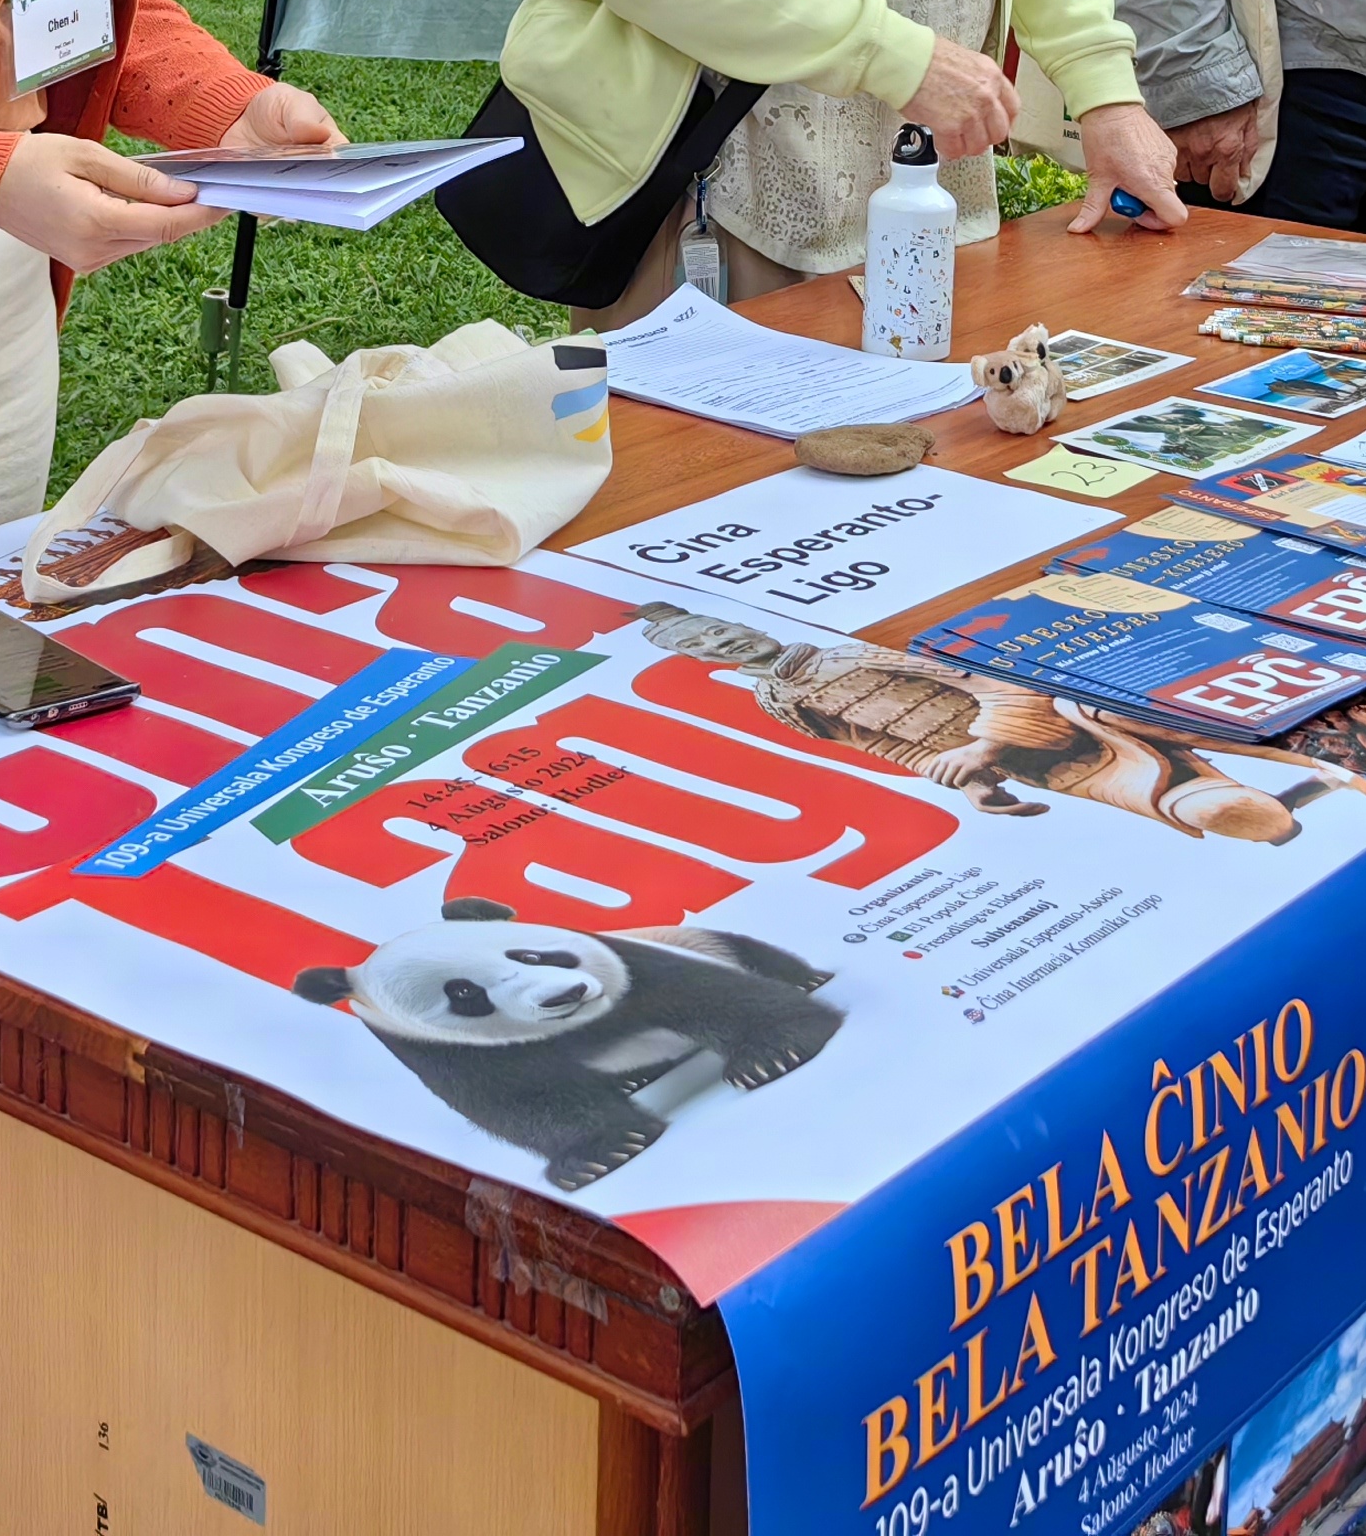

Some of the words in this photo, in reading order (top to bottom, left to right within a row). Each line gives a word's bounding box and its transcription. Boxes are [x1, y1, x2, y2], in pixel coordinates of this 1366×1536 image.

[48, 16, 69, 33] Chen
[71, 9, 79, 24] Ji
[1051, 461, 1118, 487] 23
[629, 518, 761, 565] Ĉina
[697, 493, 944, 585] Esperanto-
[766, 560, 891, 605] Ligo
[996, 610, 1110, 653] UNESKO
[1056, 611, 1161, 654] KURIERO
[1173, 657, 1341, 717] EPC
[94, 831, 172, 871] 109-a
[164, 768, 272, 833] Universala
[261, 718, 353, 776] Kongreso
[345, 702, 378, 722] de
[362, 656, 455, 708] Esperanto
[300, 743, 412, 809] Aruŝo
[411, 653, 561, 730] Tanzanio
[405, 746, 541, 810] 14:45-16:15
[426, 821, 448, 833] 4
[446, 776, 542, 824] Aŭgusto
[536, 750, 597, 778] 2024
[463, 803, 558, 848] Salono:
[551, 765, 630, 804] Hodler
[848, 867, 943, 916] Organizantoj
[858, 913, 897, 935] Ĉina
[890, 865, 983, 917] Esperanto-Ligo
[903, 920, 926, 935] El
[923, 899, 967, 929] Popola
[960, 879, 999, 901] Ĉinio
[916, 907, 996, 954] Fremdlingva
[991, 877, 1045, 910] Eldonejo
[971, 899, 1059, 949] Subtenantoj
[957, 944, 1027, 989] Universala
[1021, 885, 1123, 950] Esperanto-Asocio
[979, 988, 1015, 1013] Ĉina
[1014, 950, 1073, 994] Internacia
[1065, 915, 1129, 957] Komunika
[1121, 892, 1163, 919] Grupo
[944, 1129, 1132, 1334] BELA
[1143, 997, 1312, 1177] ĈINIO
[875, 1473, 960, 1536] 109-a
[967, 1355, 1103, 1497] Universala
[1109, 1263, 1218, 1382] Kongreso
[1221, 1233, 1249, 1283] de
[1252, 1149, 1354, 1260] Esperanto
[860, 1290, 1058, 1510] BELA
[1009, 1417, 1107, 1528] Aruŝo
[1135, 1286, 1260, 1417] Tanzanio
[1078, 1483, 1091, 1504] 4
[1093, 1424, 1161, 1498] Aŭgusto
[1161, 1381, 1199, 1437] 2024
[1143, 1425, 1197, 1491] Hodler
